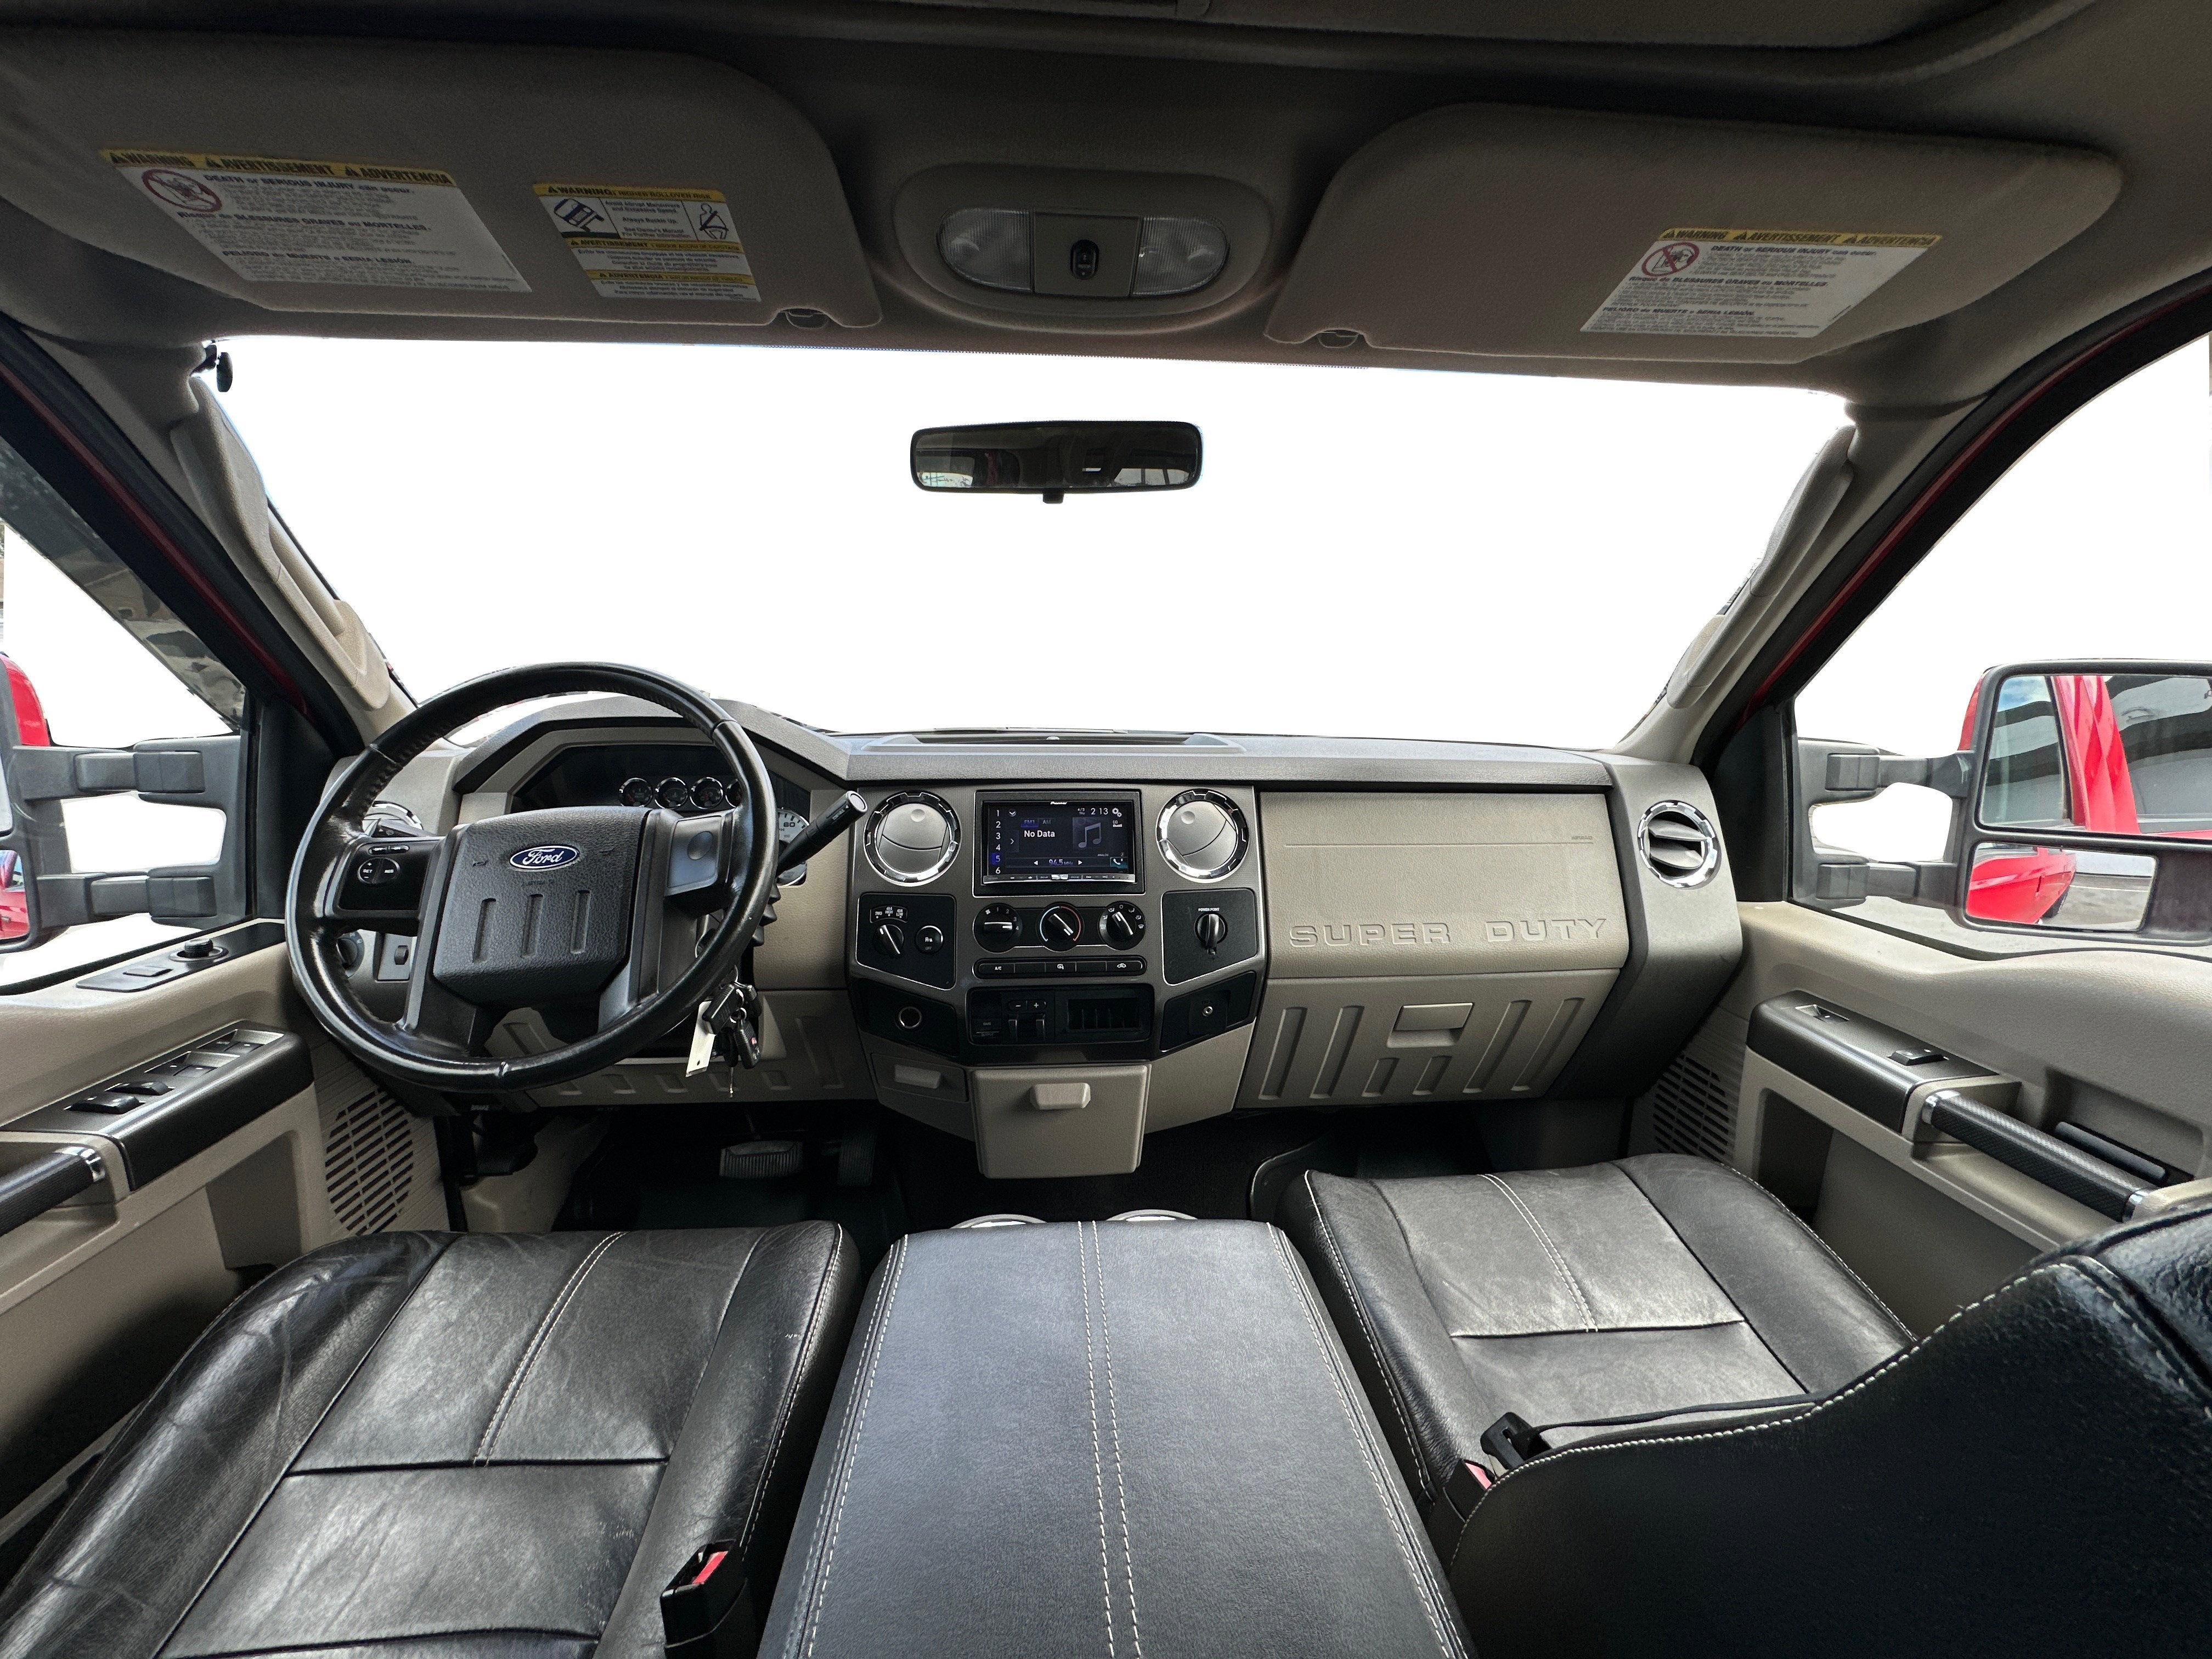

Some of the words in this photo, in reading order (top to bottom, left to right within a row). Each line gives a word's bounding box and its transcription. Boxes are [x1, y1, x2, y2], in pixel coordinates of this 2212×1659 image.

[121, 153, 195, 166] WARNING
[221, 158, 335, 174] AVERTISSEMENT
[360, 167, 453, 184] ADVERTENCIA
[261, 178, 312, 187] SERIOUS
[1676, 230, 1729, 240] WARNING
[1747, 232, 1842, 243] AVERTISSEMENT
[1858, 235, 1937, 245] ADVERTENCIA
[522, 848, 565, 865] Ford
[1289, 922, 1451, 947] SUPER
[1485, 918, 1607, 943] DUTY
